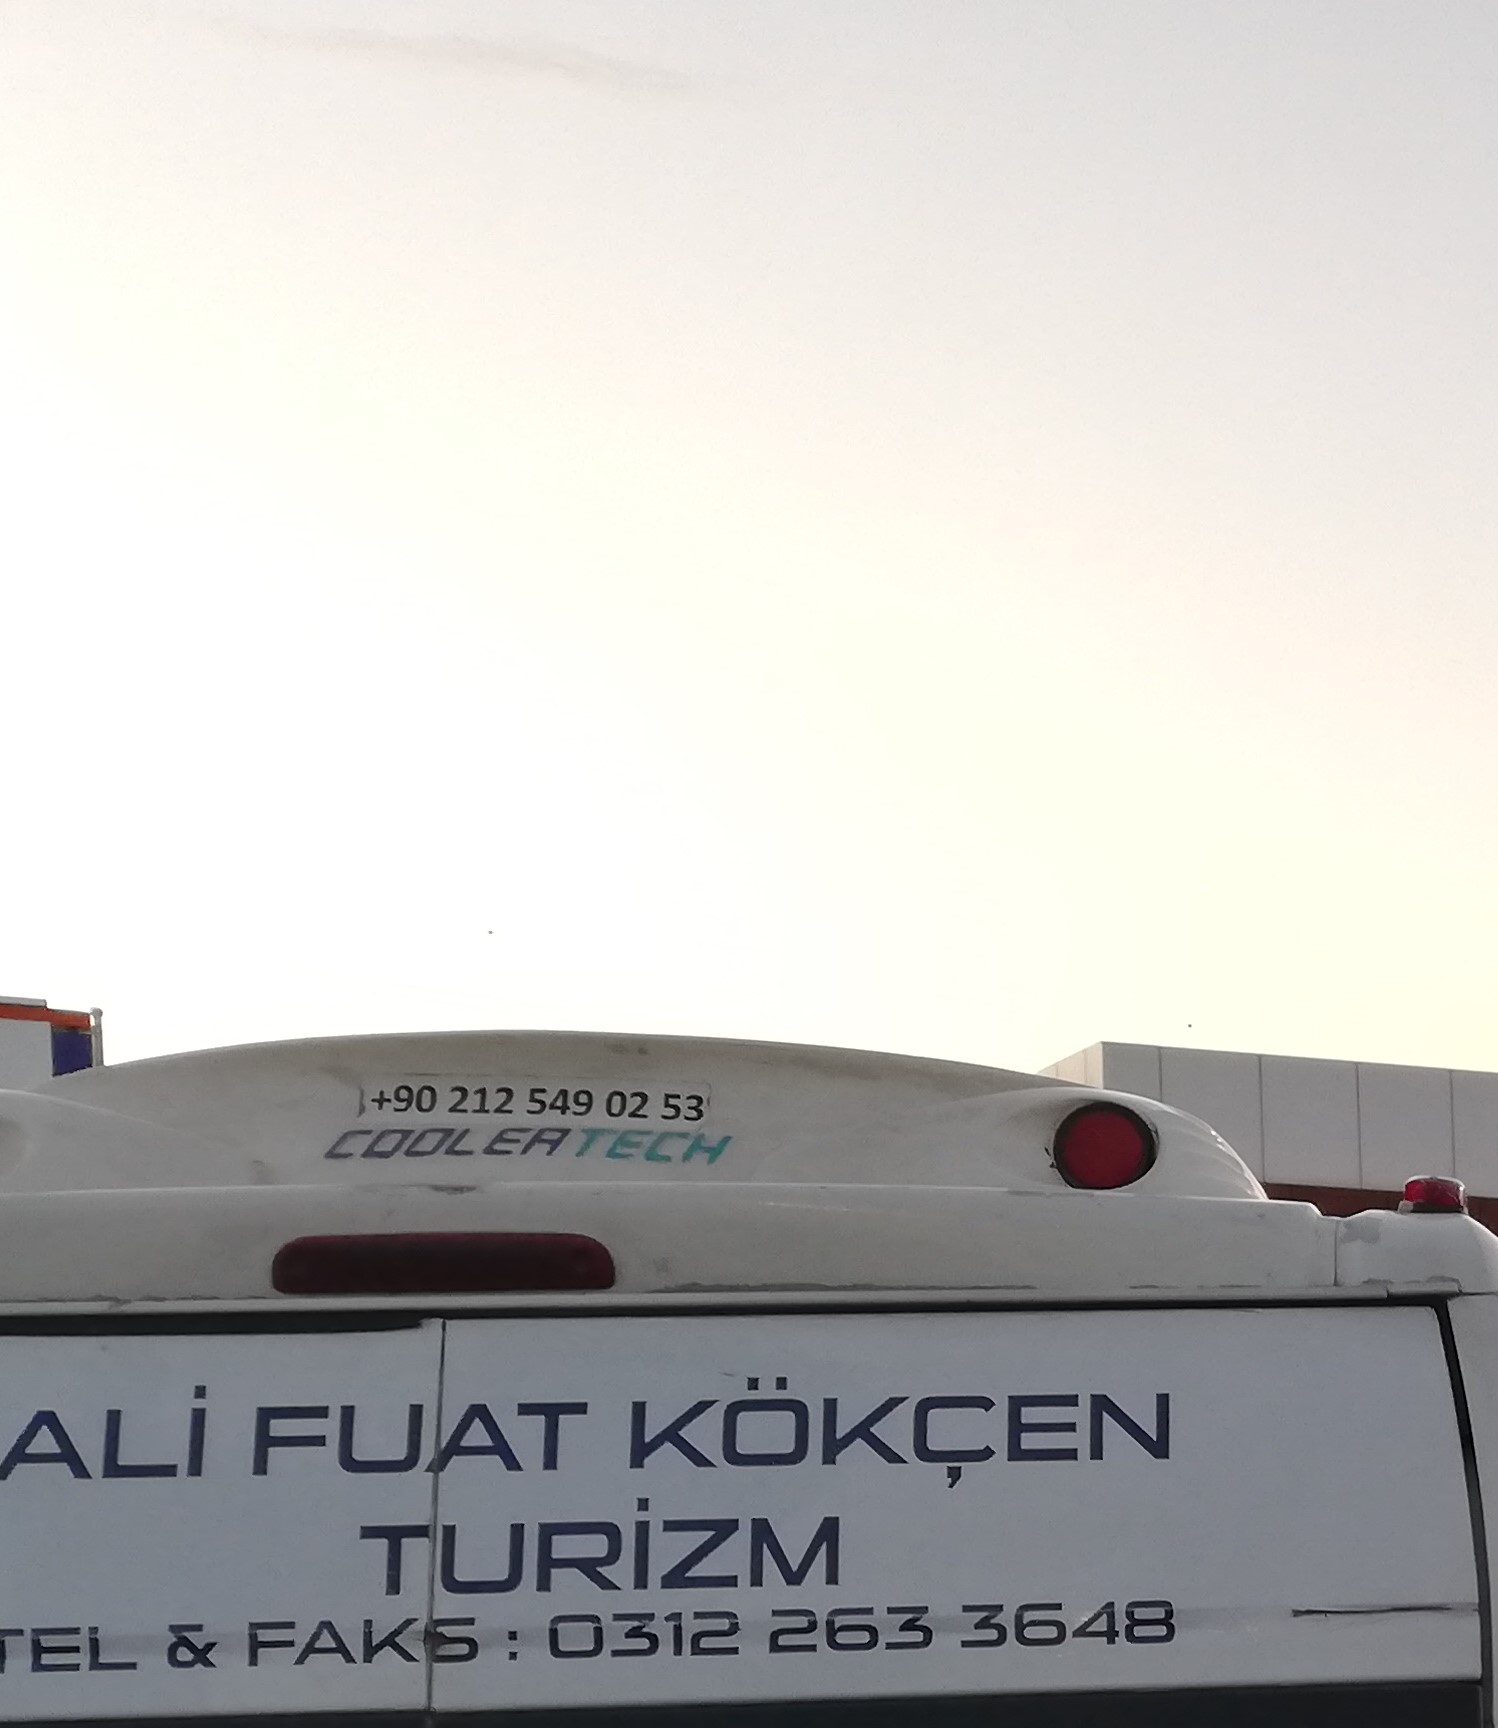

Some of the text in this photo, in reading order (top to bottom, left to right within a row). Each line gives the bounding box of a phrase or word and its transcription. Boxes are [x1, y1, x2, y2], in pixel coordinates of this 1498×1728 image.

[371, 1085, 704, 1121] +90 212 549 02 53
[324, 1127, 733, 1165] COOLERTECH
[0, 1376, 1170, 1488] ALİ FUAT KÖKÇEN
[360, 1497, 840, 1596] TURİZM
[167, 1623, 219, 1668] &
[248, 1617, 479, 1667] FAKS
[549, 1611, 740, 1658] 0312
[769, 1606, 933, 1653] 263
[961, 1600, 1175, 1647] 3648
